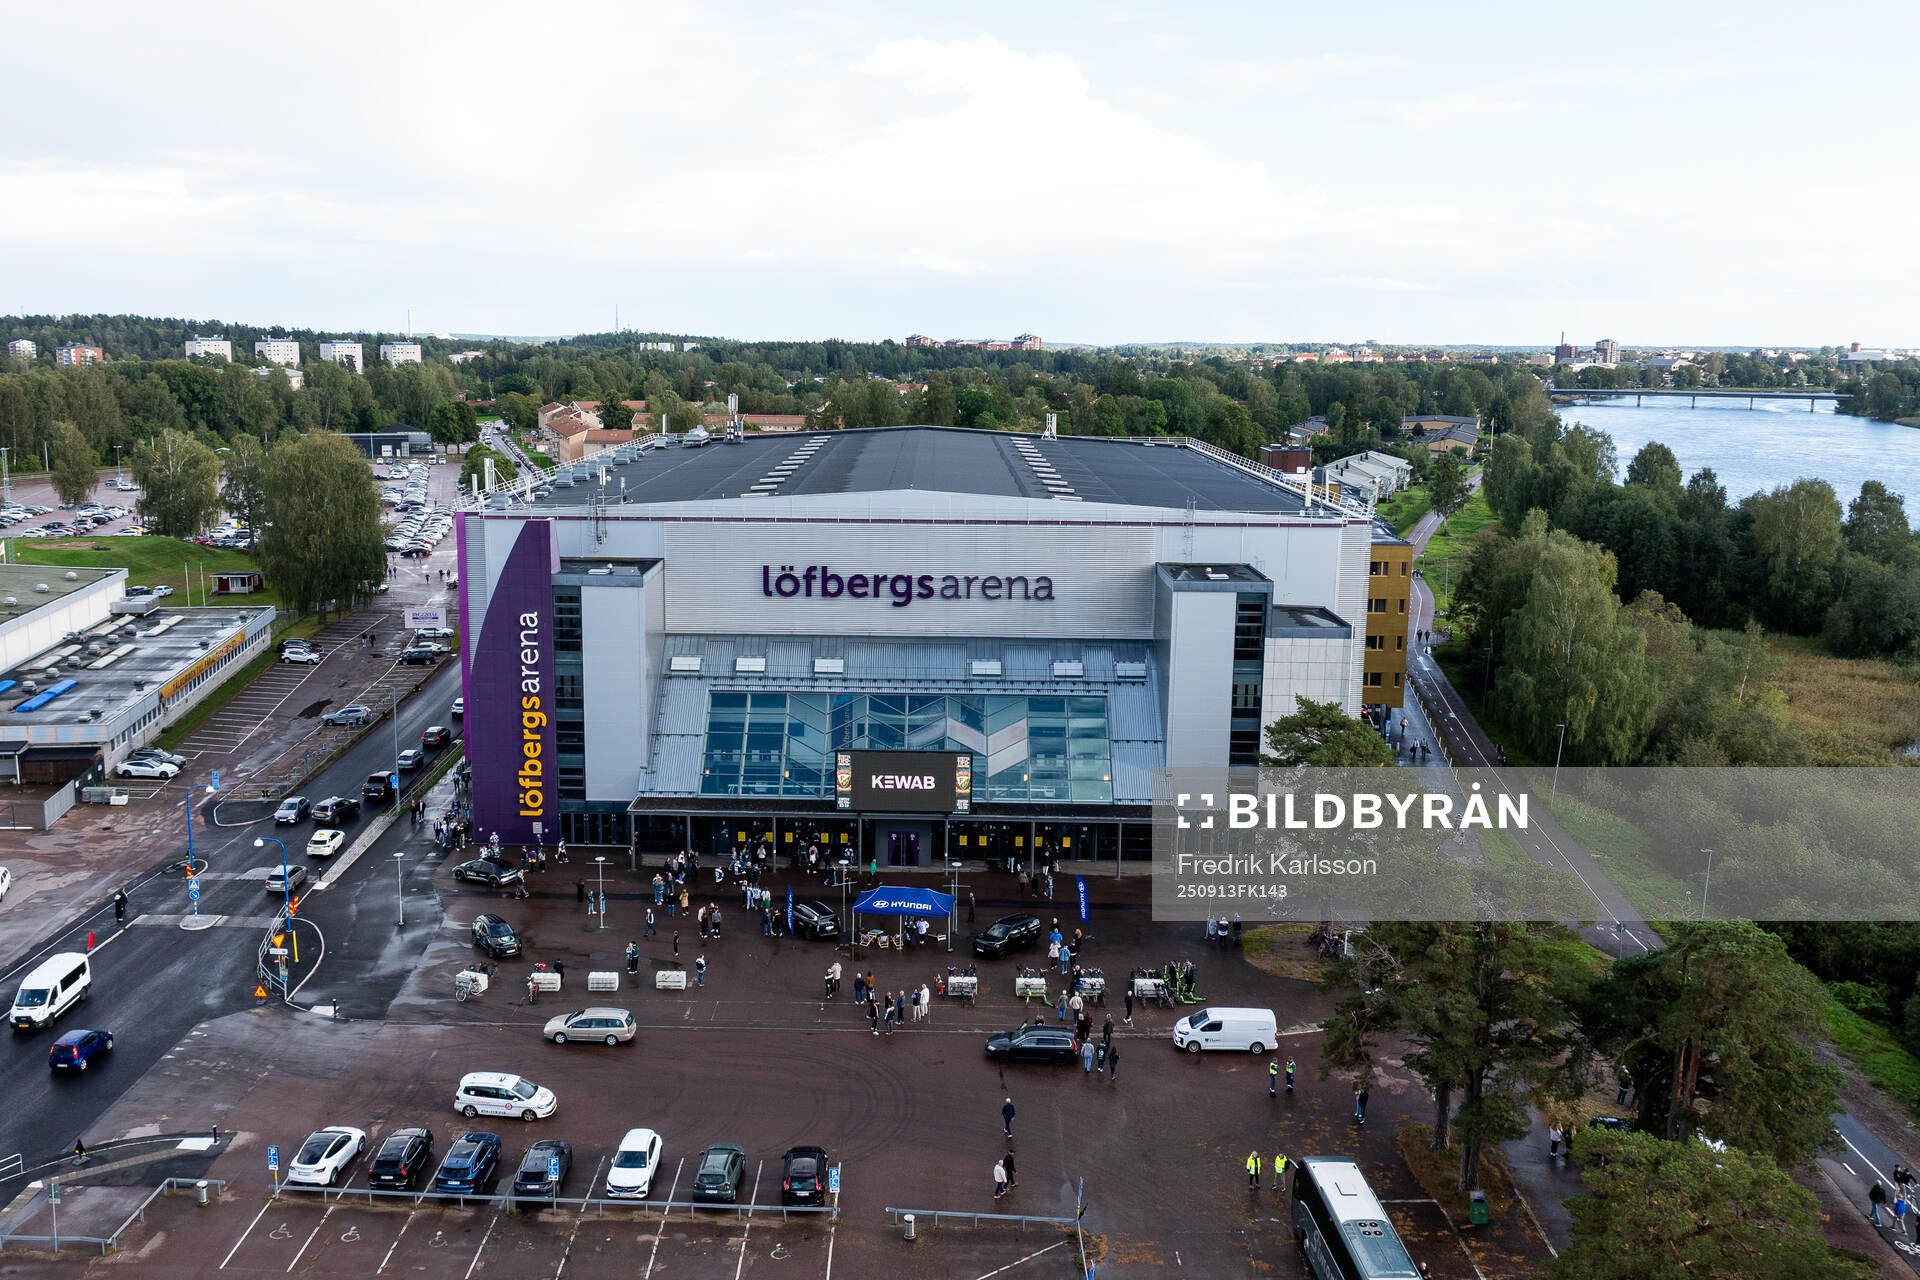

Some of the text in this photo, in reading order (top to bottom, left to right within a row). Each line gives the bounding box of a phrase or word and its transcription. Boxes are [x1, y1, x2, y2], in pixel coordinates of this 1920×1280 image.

[762, 565, 1056, 608] löfbergsarena
[518, 611, 547, 817] löfbergsarena
[871, 774, 936, 790] KEWAB
[891, 901, 932, 911] HYUNDAI
